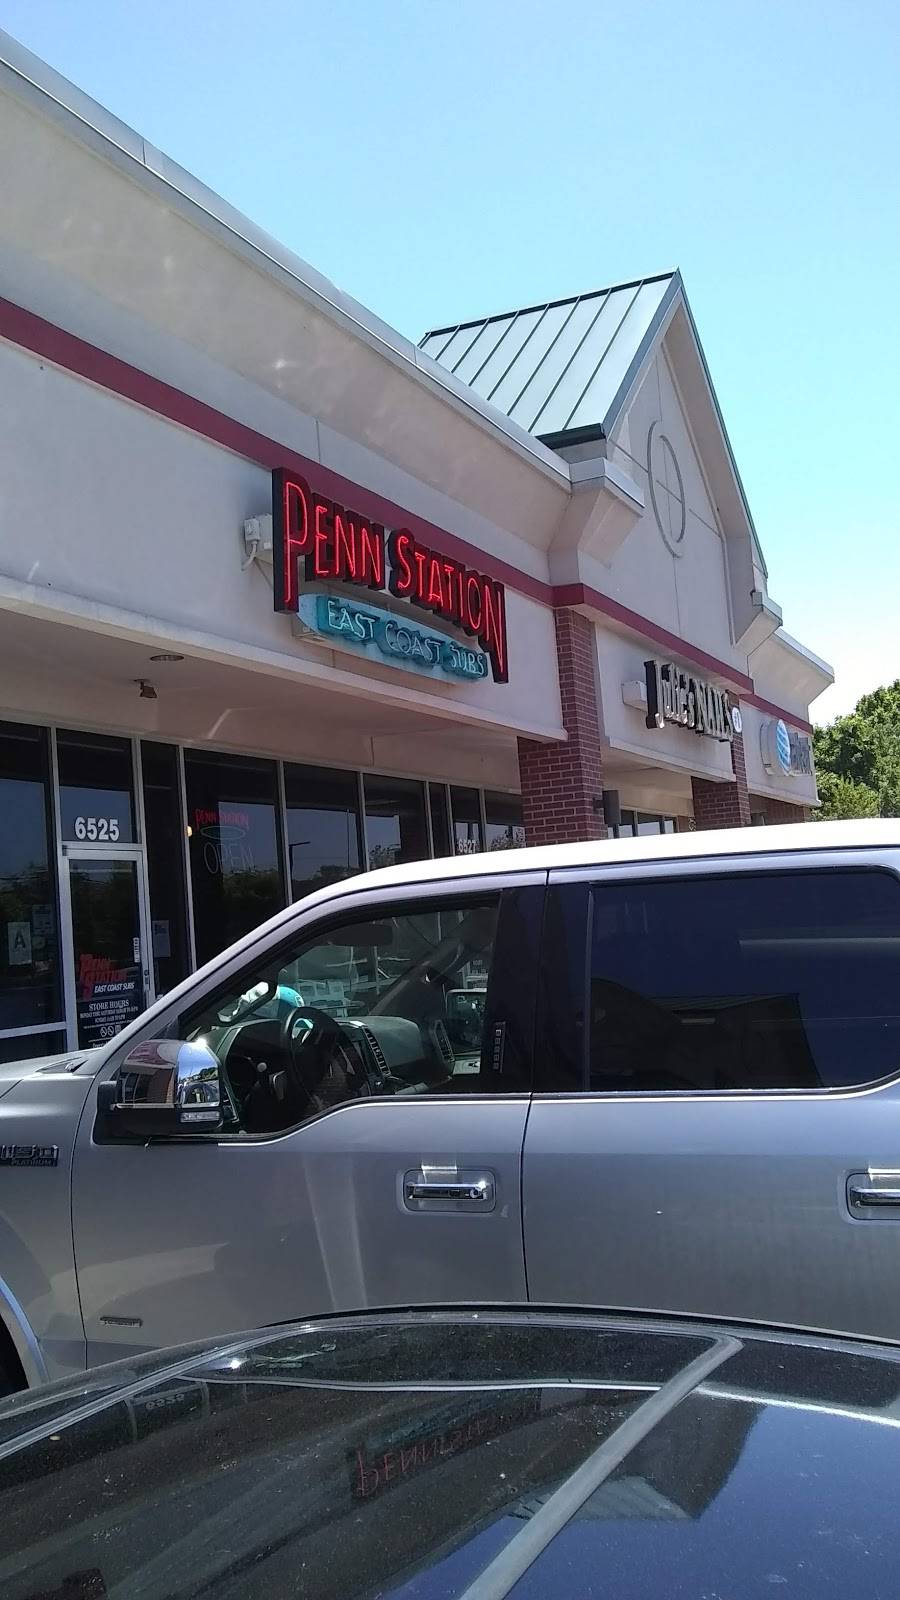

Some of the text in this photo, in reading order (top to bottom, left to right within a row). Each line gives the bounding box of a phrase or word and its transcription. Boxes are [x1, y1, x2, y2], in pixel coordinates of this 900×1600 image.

[275, 471, 507, 682] PENN STATION
[322, 599, 487, 678] EAST COAST SUBS
[74, 816, 120, 841] 6525
[94, 984, 107, 994] EAST
[107, 983, 122, 992] COAST
[89, 1001, 109, 1012] STORE
